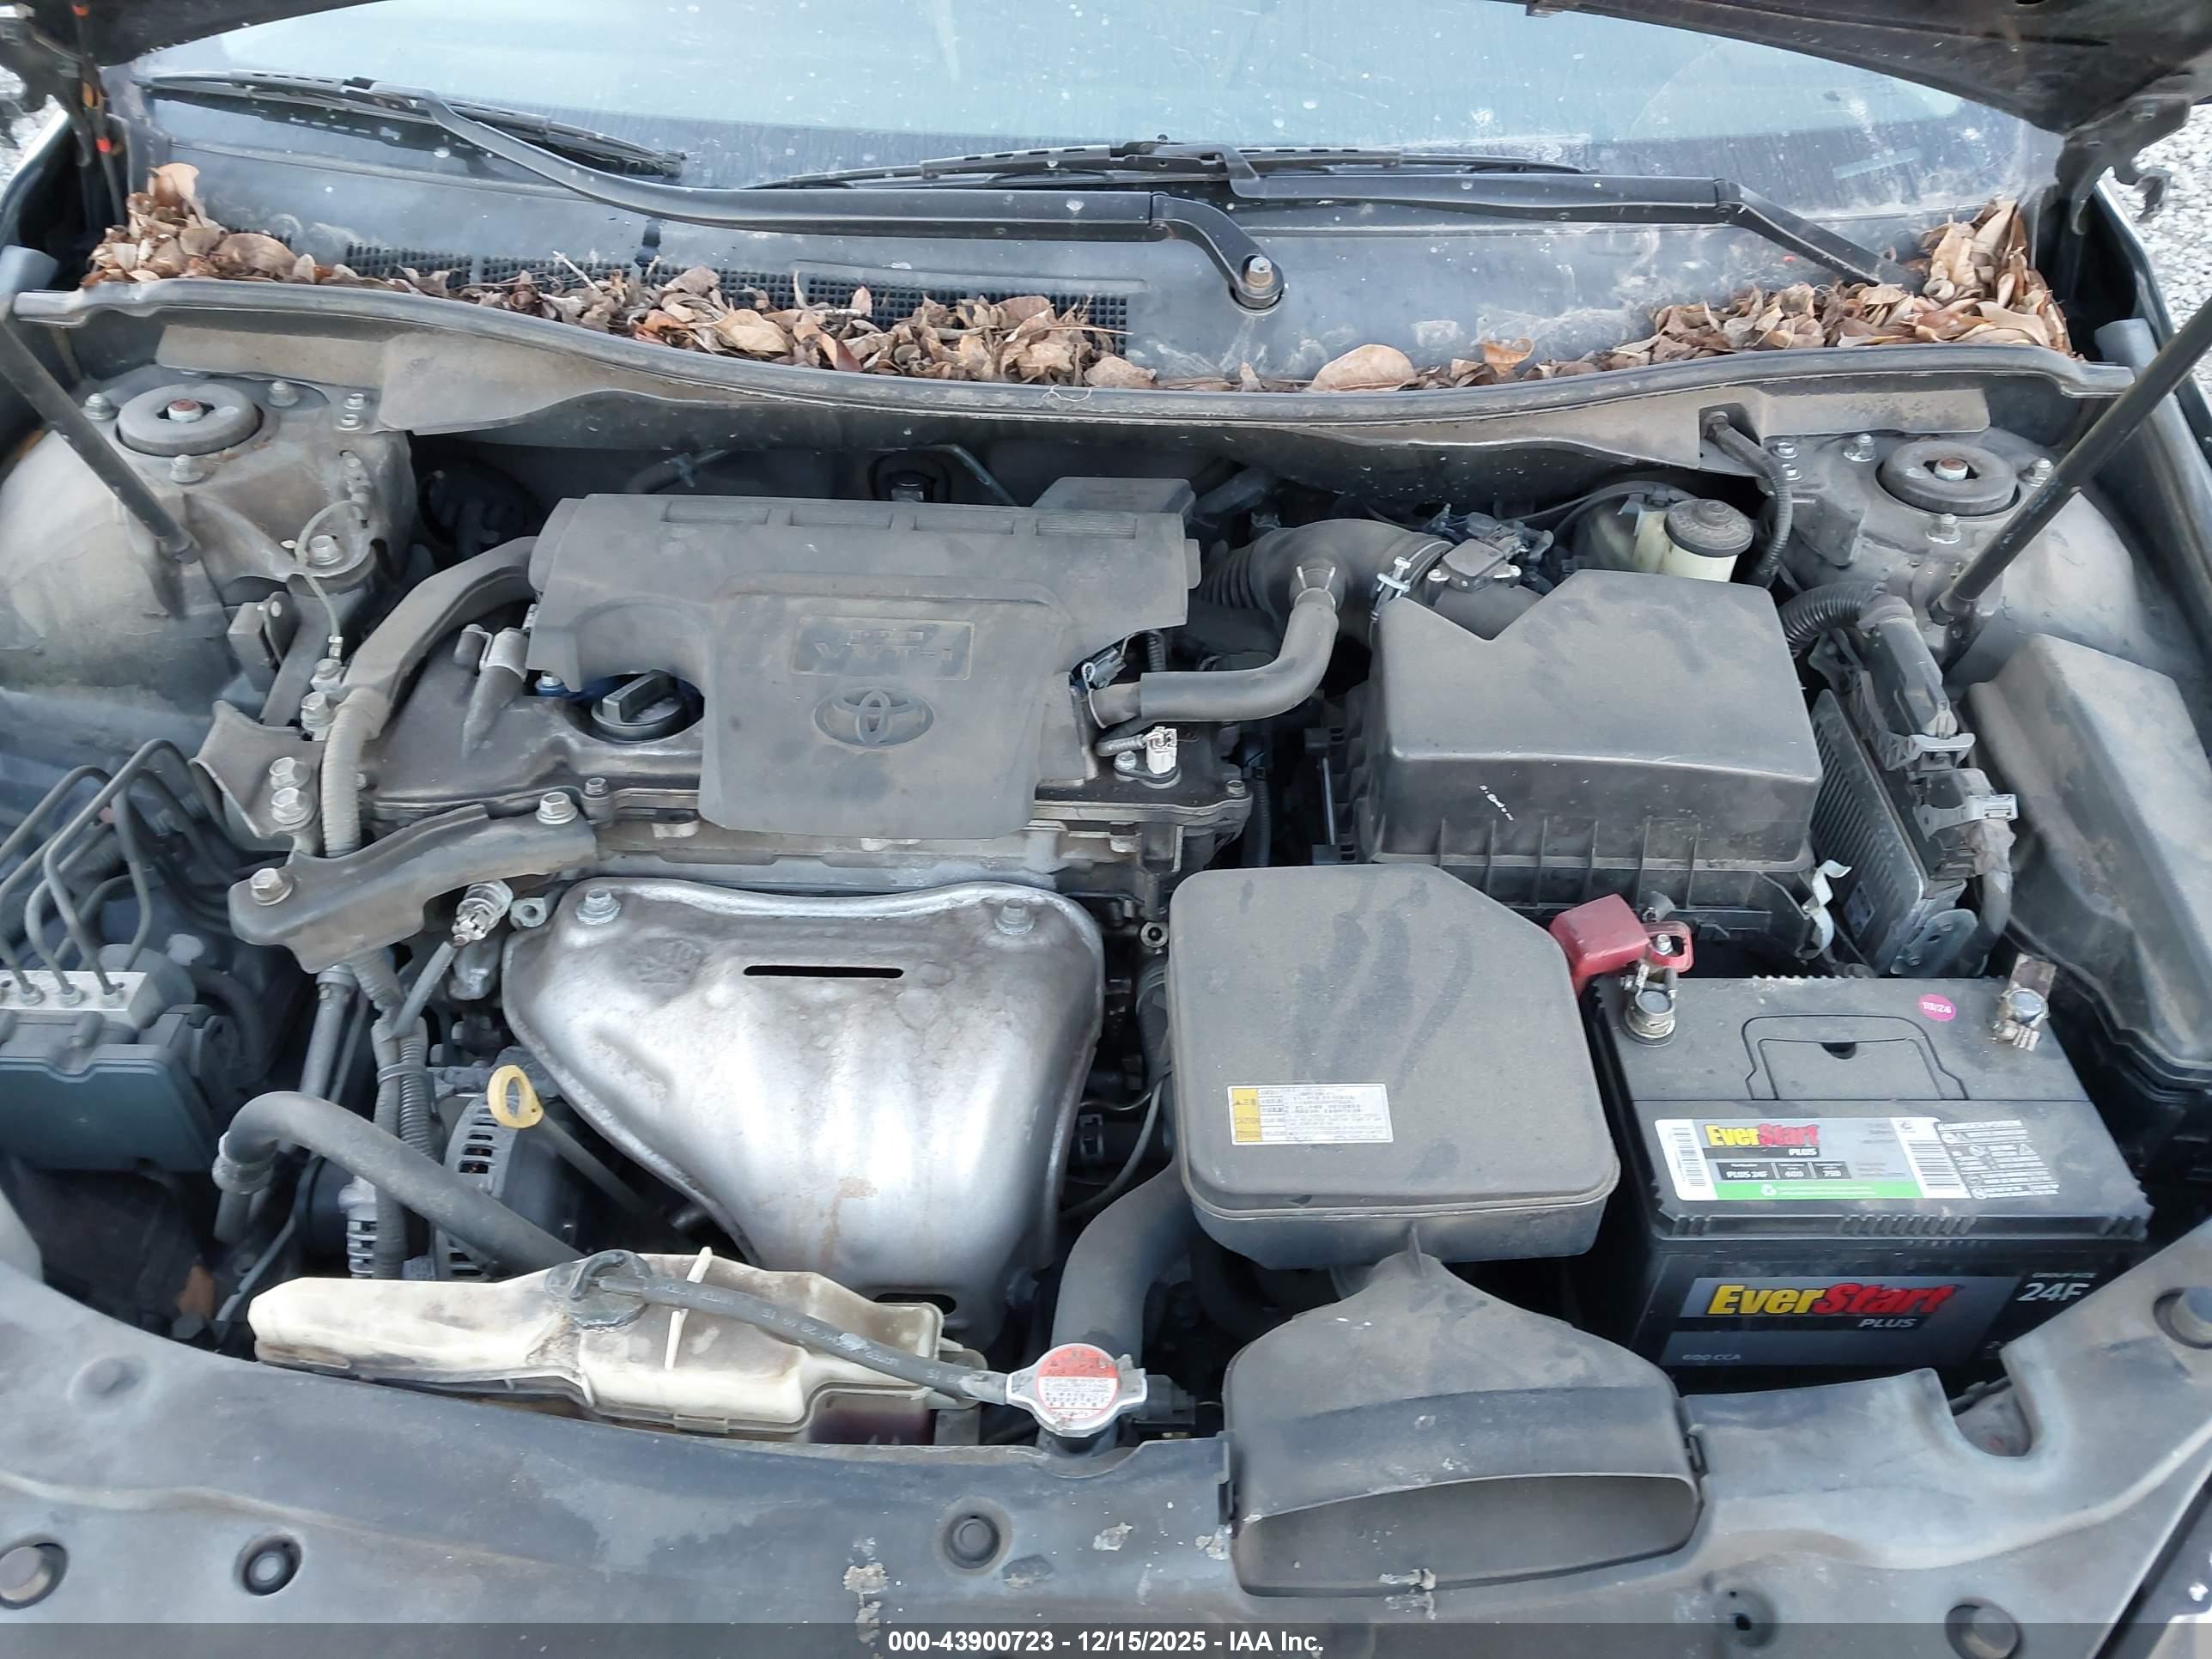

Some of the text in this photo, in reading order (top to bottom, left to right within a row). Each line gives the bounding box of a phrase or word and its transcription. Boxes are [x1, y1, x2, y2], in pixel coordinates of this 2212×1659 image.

[1704, 1122, 1820, 1147] EverStart
[1788, 1148, 1818, 1157] PLUS
[1707, 1283, 1958, 1316] EverStart
[2015, 1282, 2091, 1301] 24F
[1857, 1318, 1918, 1328] PLUS
